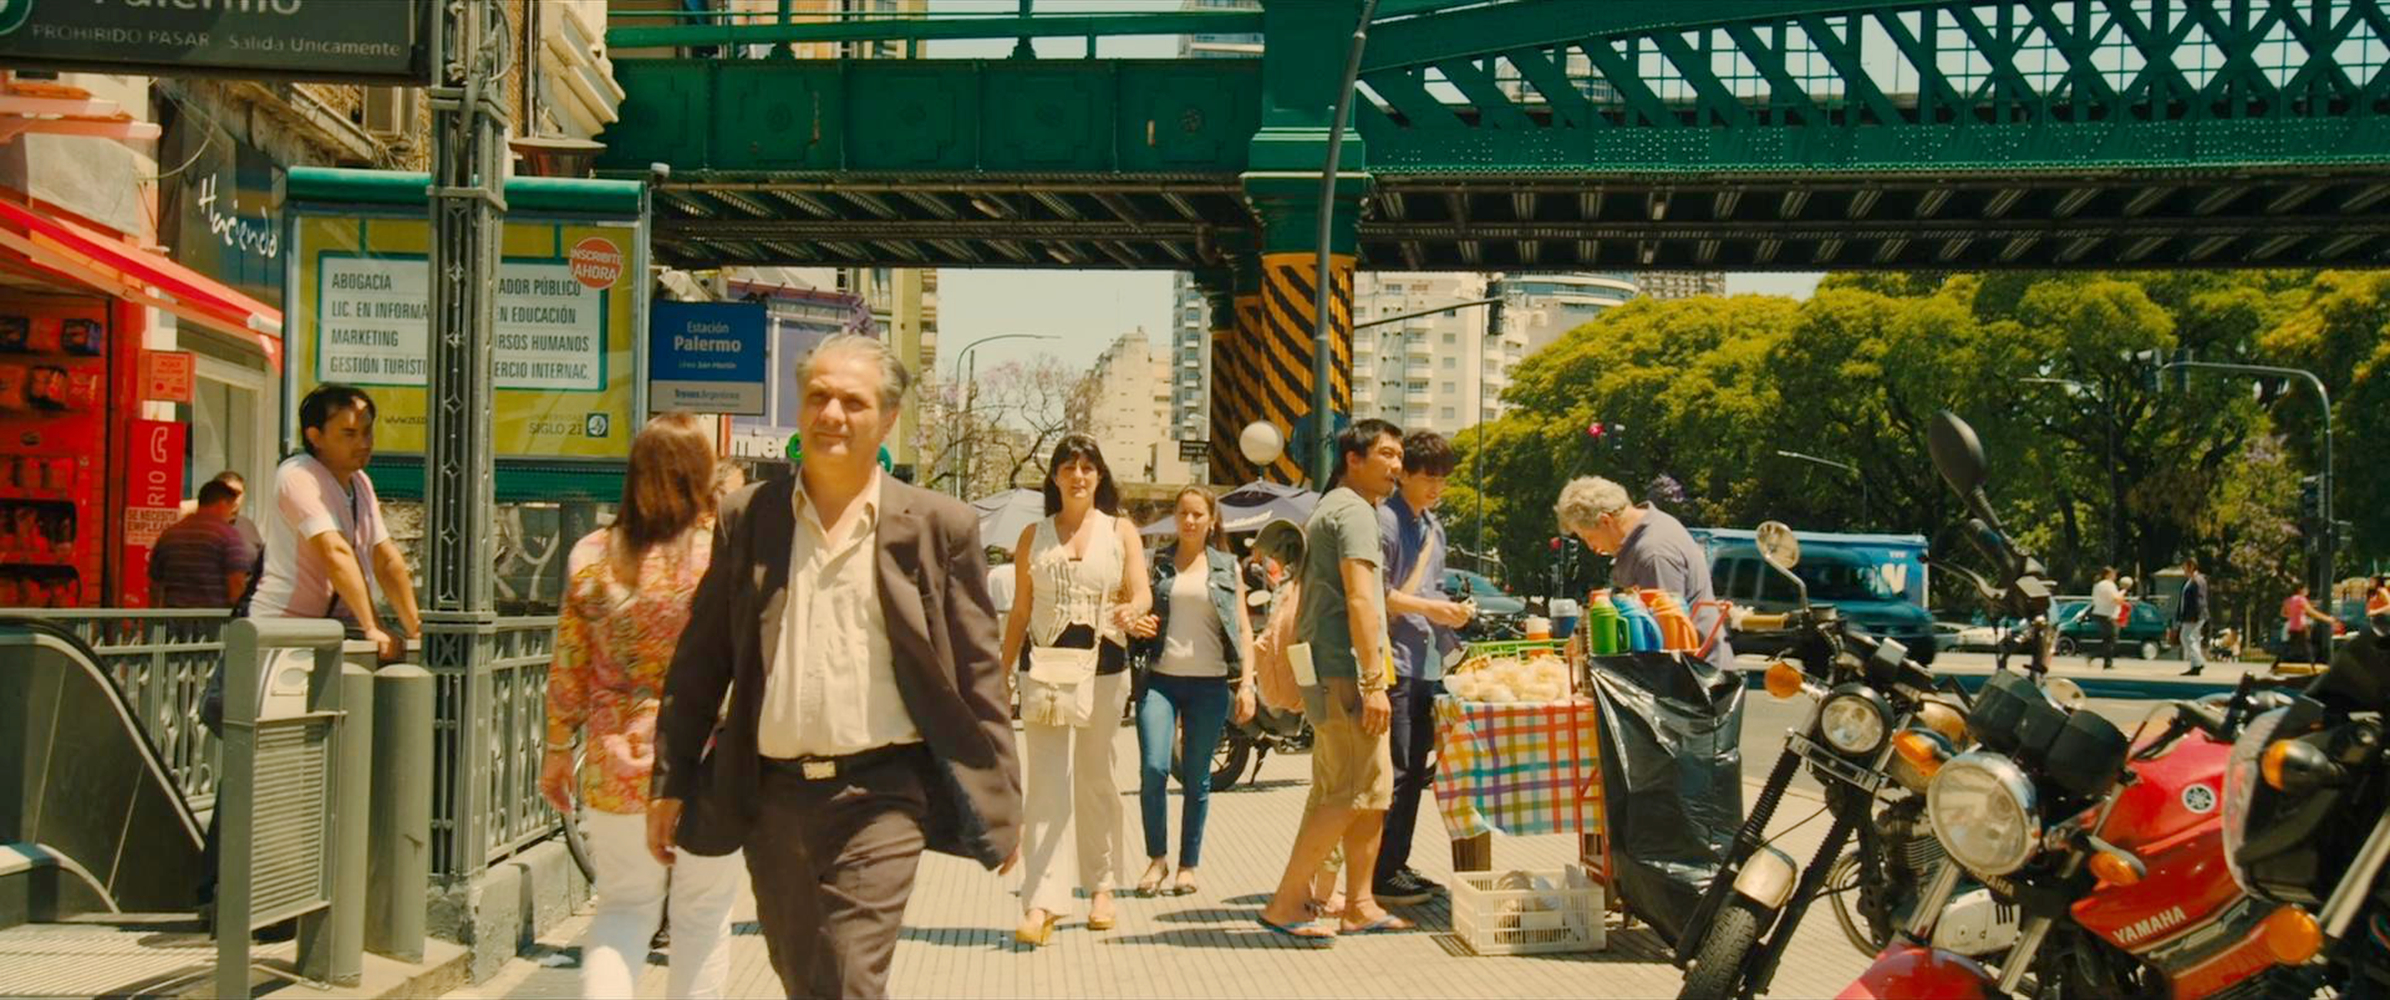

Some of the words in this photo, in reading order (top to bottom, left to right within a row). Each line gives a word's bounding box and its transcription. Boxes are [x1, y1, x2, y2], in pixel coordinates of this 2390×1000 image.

[32, 24, 142, 44] PROHIBIDO
[149, 30, 210, 46] PASAR
[228, 34, 284, 50] Salida
[198, 173, 278, 258] Haciendo
[574, 262, 617, 280] AHORA
[498, 278, 530, 295] ADOR
[533, 276, 581, 296] PÚBLICO
[332, 301, 351, 318] LIC.
[356, 302, 371, 318] EN
[376, 302, 429, 320] INFORMA
[497, 306, 508, 322] N
[512, 305, 576, 324] EDUCACIÓN
[686, 320, 730, 334] Estación
[331, 328, 398, 347] MARKETING
[495, 334, 528, 350] RSOS
[531, 335, 589, 352] HUMANOS
[674, 335, 742, 353] Palermo
[330, 355, 379, 374] GESTIÓN
[384, 355, 427, 375] TURÍSTI
[494, 361, 528, 378] ERCIO
[531, 362, 590, 380] INTERNAC.
[528, 422, 566, 435] SIGLO
[568, 423, 583, 436] 21
[2113, 905, 2187, 944] YAMAHA
